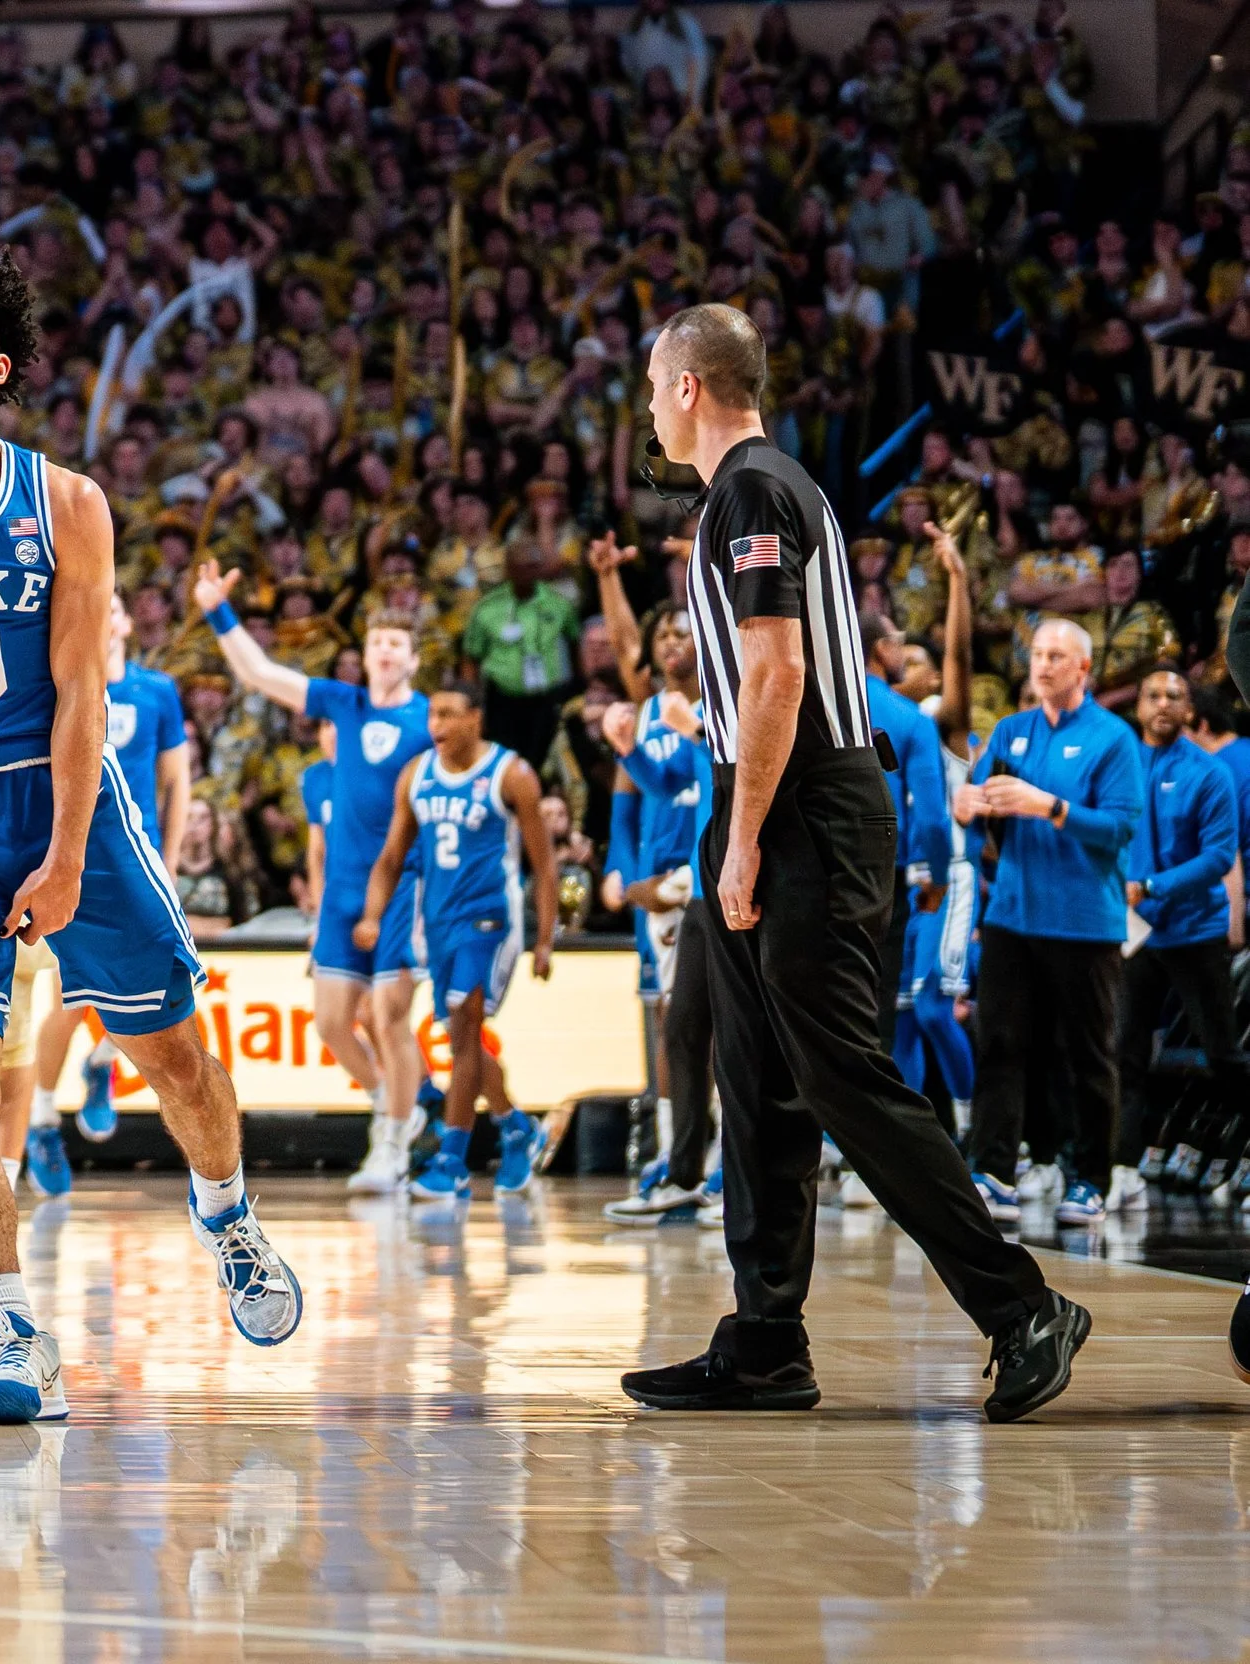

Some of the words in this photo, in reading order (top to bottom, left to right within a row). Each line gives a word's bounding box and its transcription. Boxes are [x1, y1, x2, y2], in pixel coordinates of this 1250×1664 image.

[928, 351, 1022, 423] WF
[1151, 344, 1244, 420] WF
[415, 795, 488, 832] DUKE
[436, 822, 461, 870] 2
